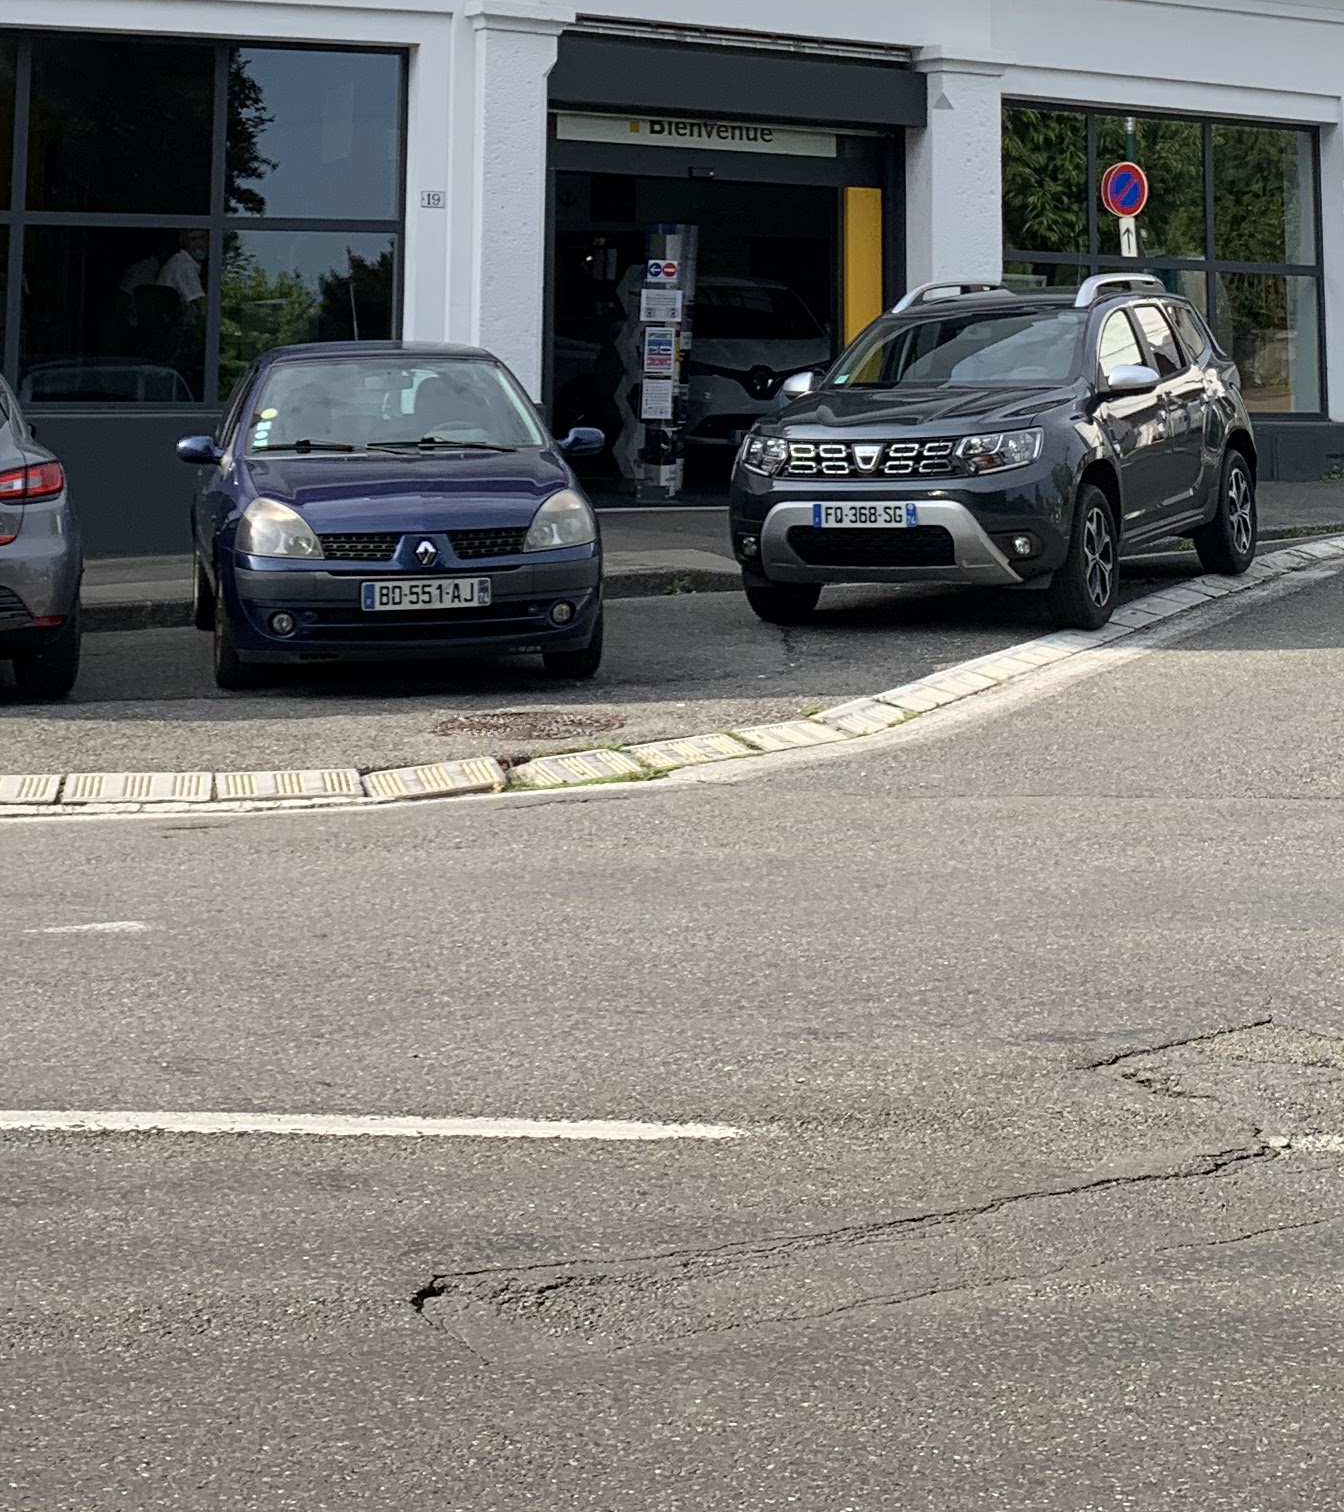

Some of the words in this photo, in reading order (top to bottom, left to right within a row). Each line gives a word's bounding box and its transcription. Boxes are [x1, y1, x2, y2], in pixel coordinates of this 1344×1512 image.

[648, 119, 774, 143] Bienvenue
[427, 193, 441, 206] 19
[824, 506, 903, 524] FQ-368-SG
[379, 582, 474, 606] BD-551-AJ
